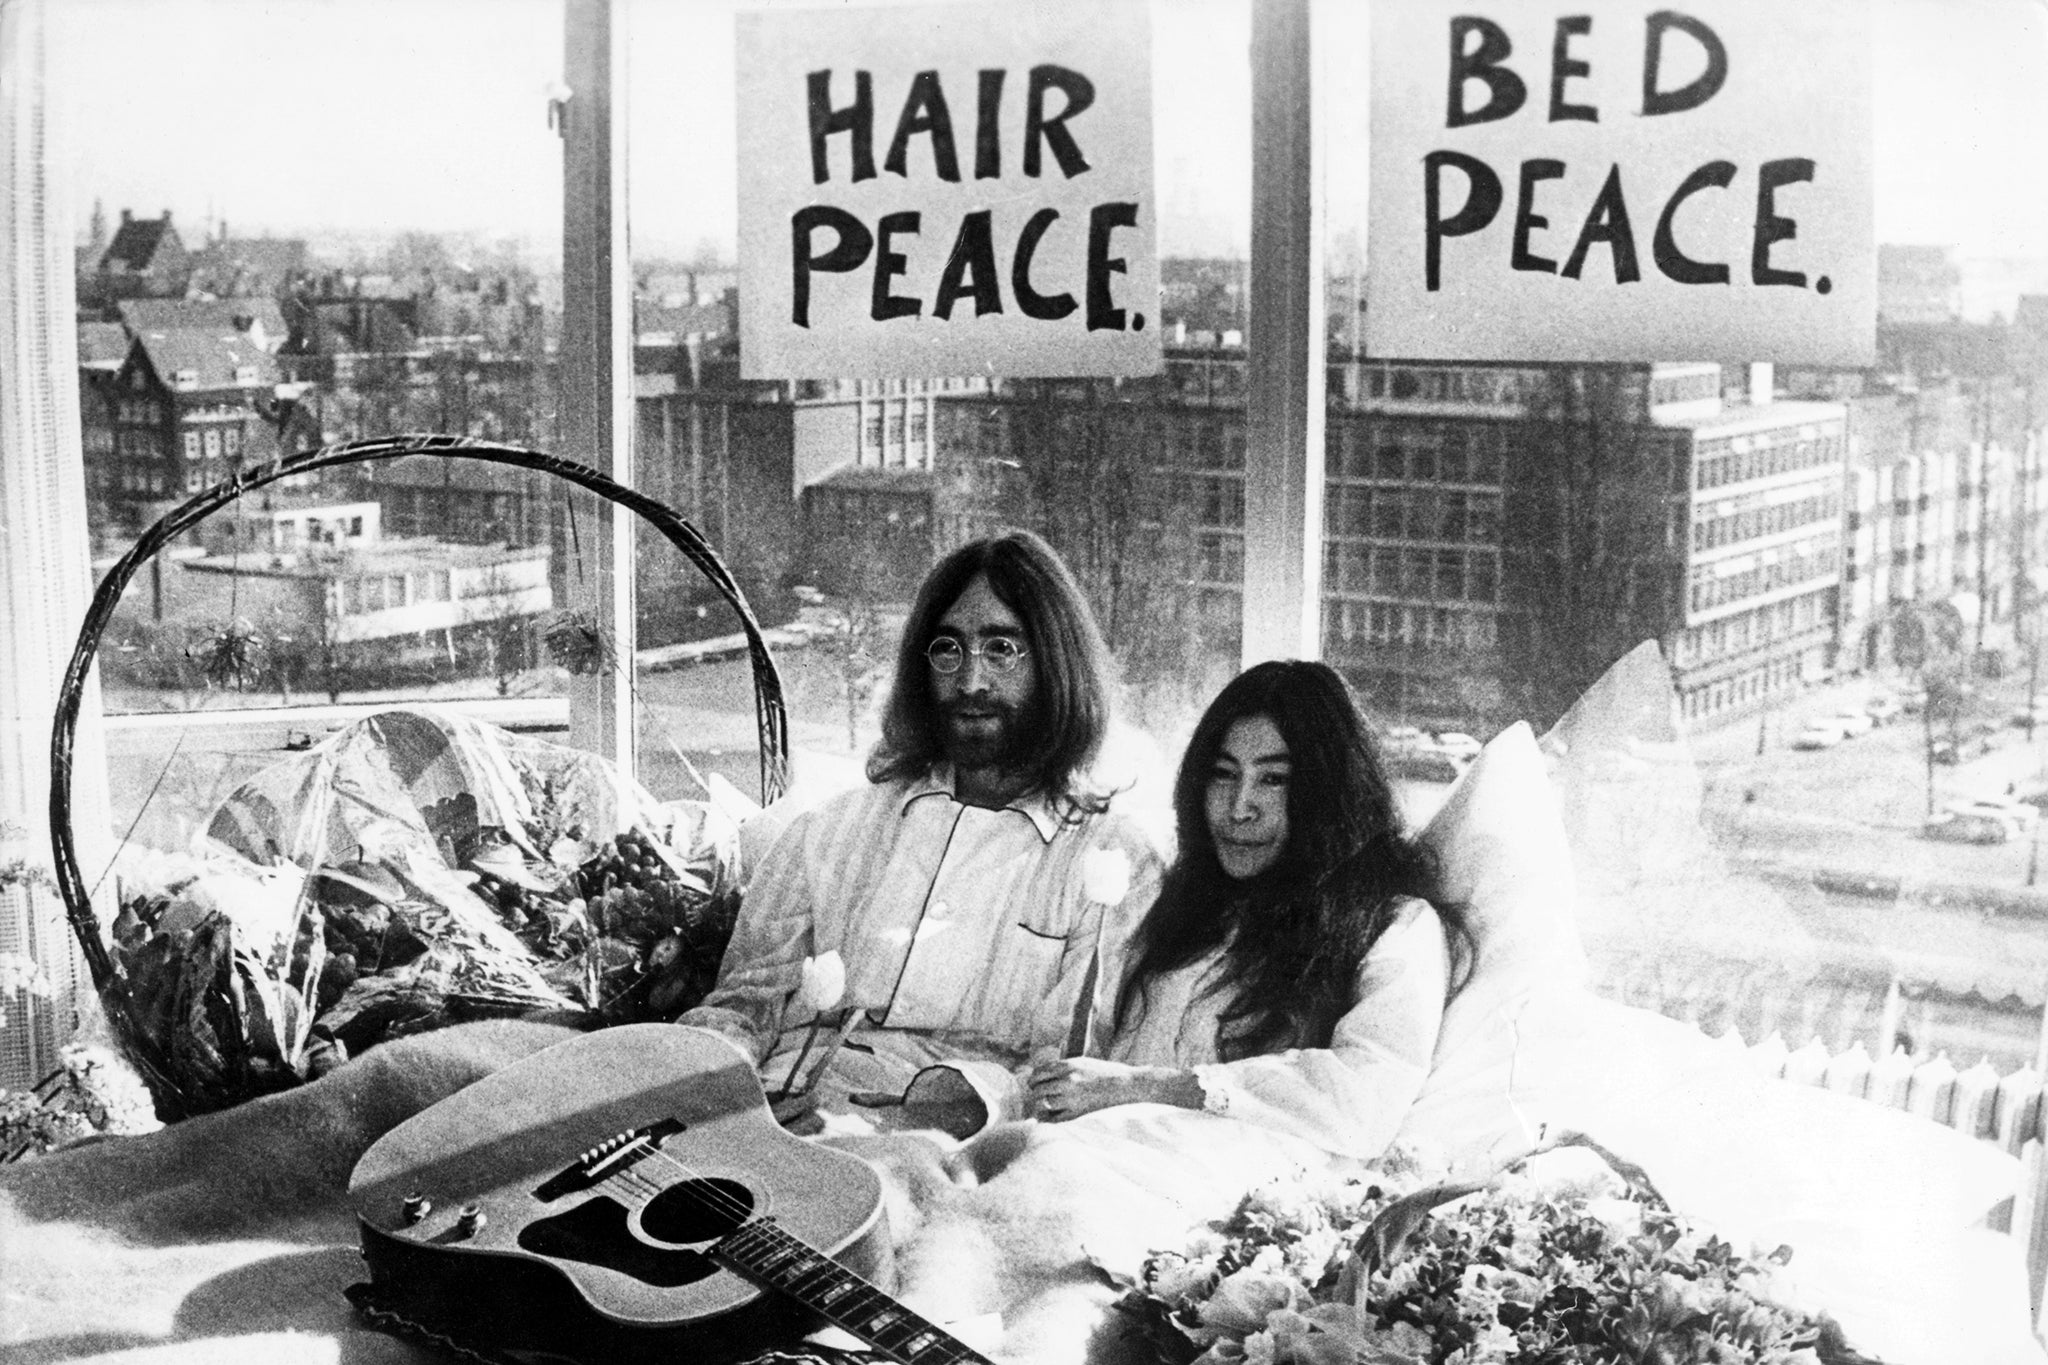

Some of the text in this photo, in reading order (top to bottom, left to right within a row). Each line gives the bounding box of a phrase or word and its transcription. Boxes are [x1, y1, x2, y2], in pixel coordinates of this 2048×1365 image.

[806, 63, 1096, 185] HAIR
[1445, 10, 1728, 128] BED
[791, 201, 1146, 333] PEACE.
[1423, 150, 1832, 295] PEACE.
